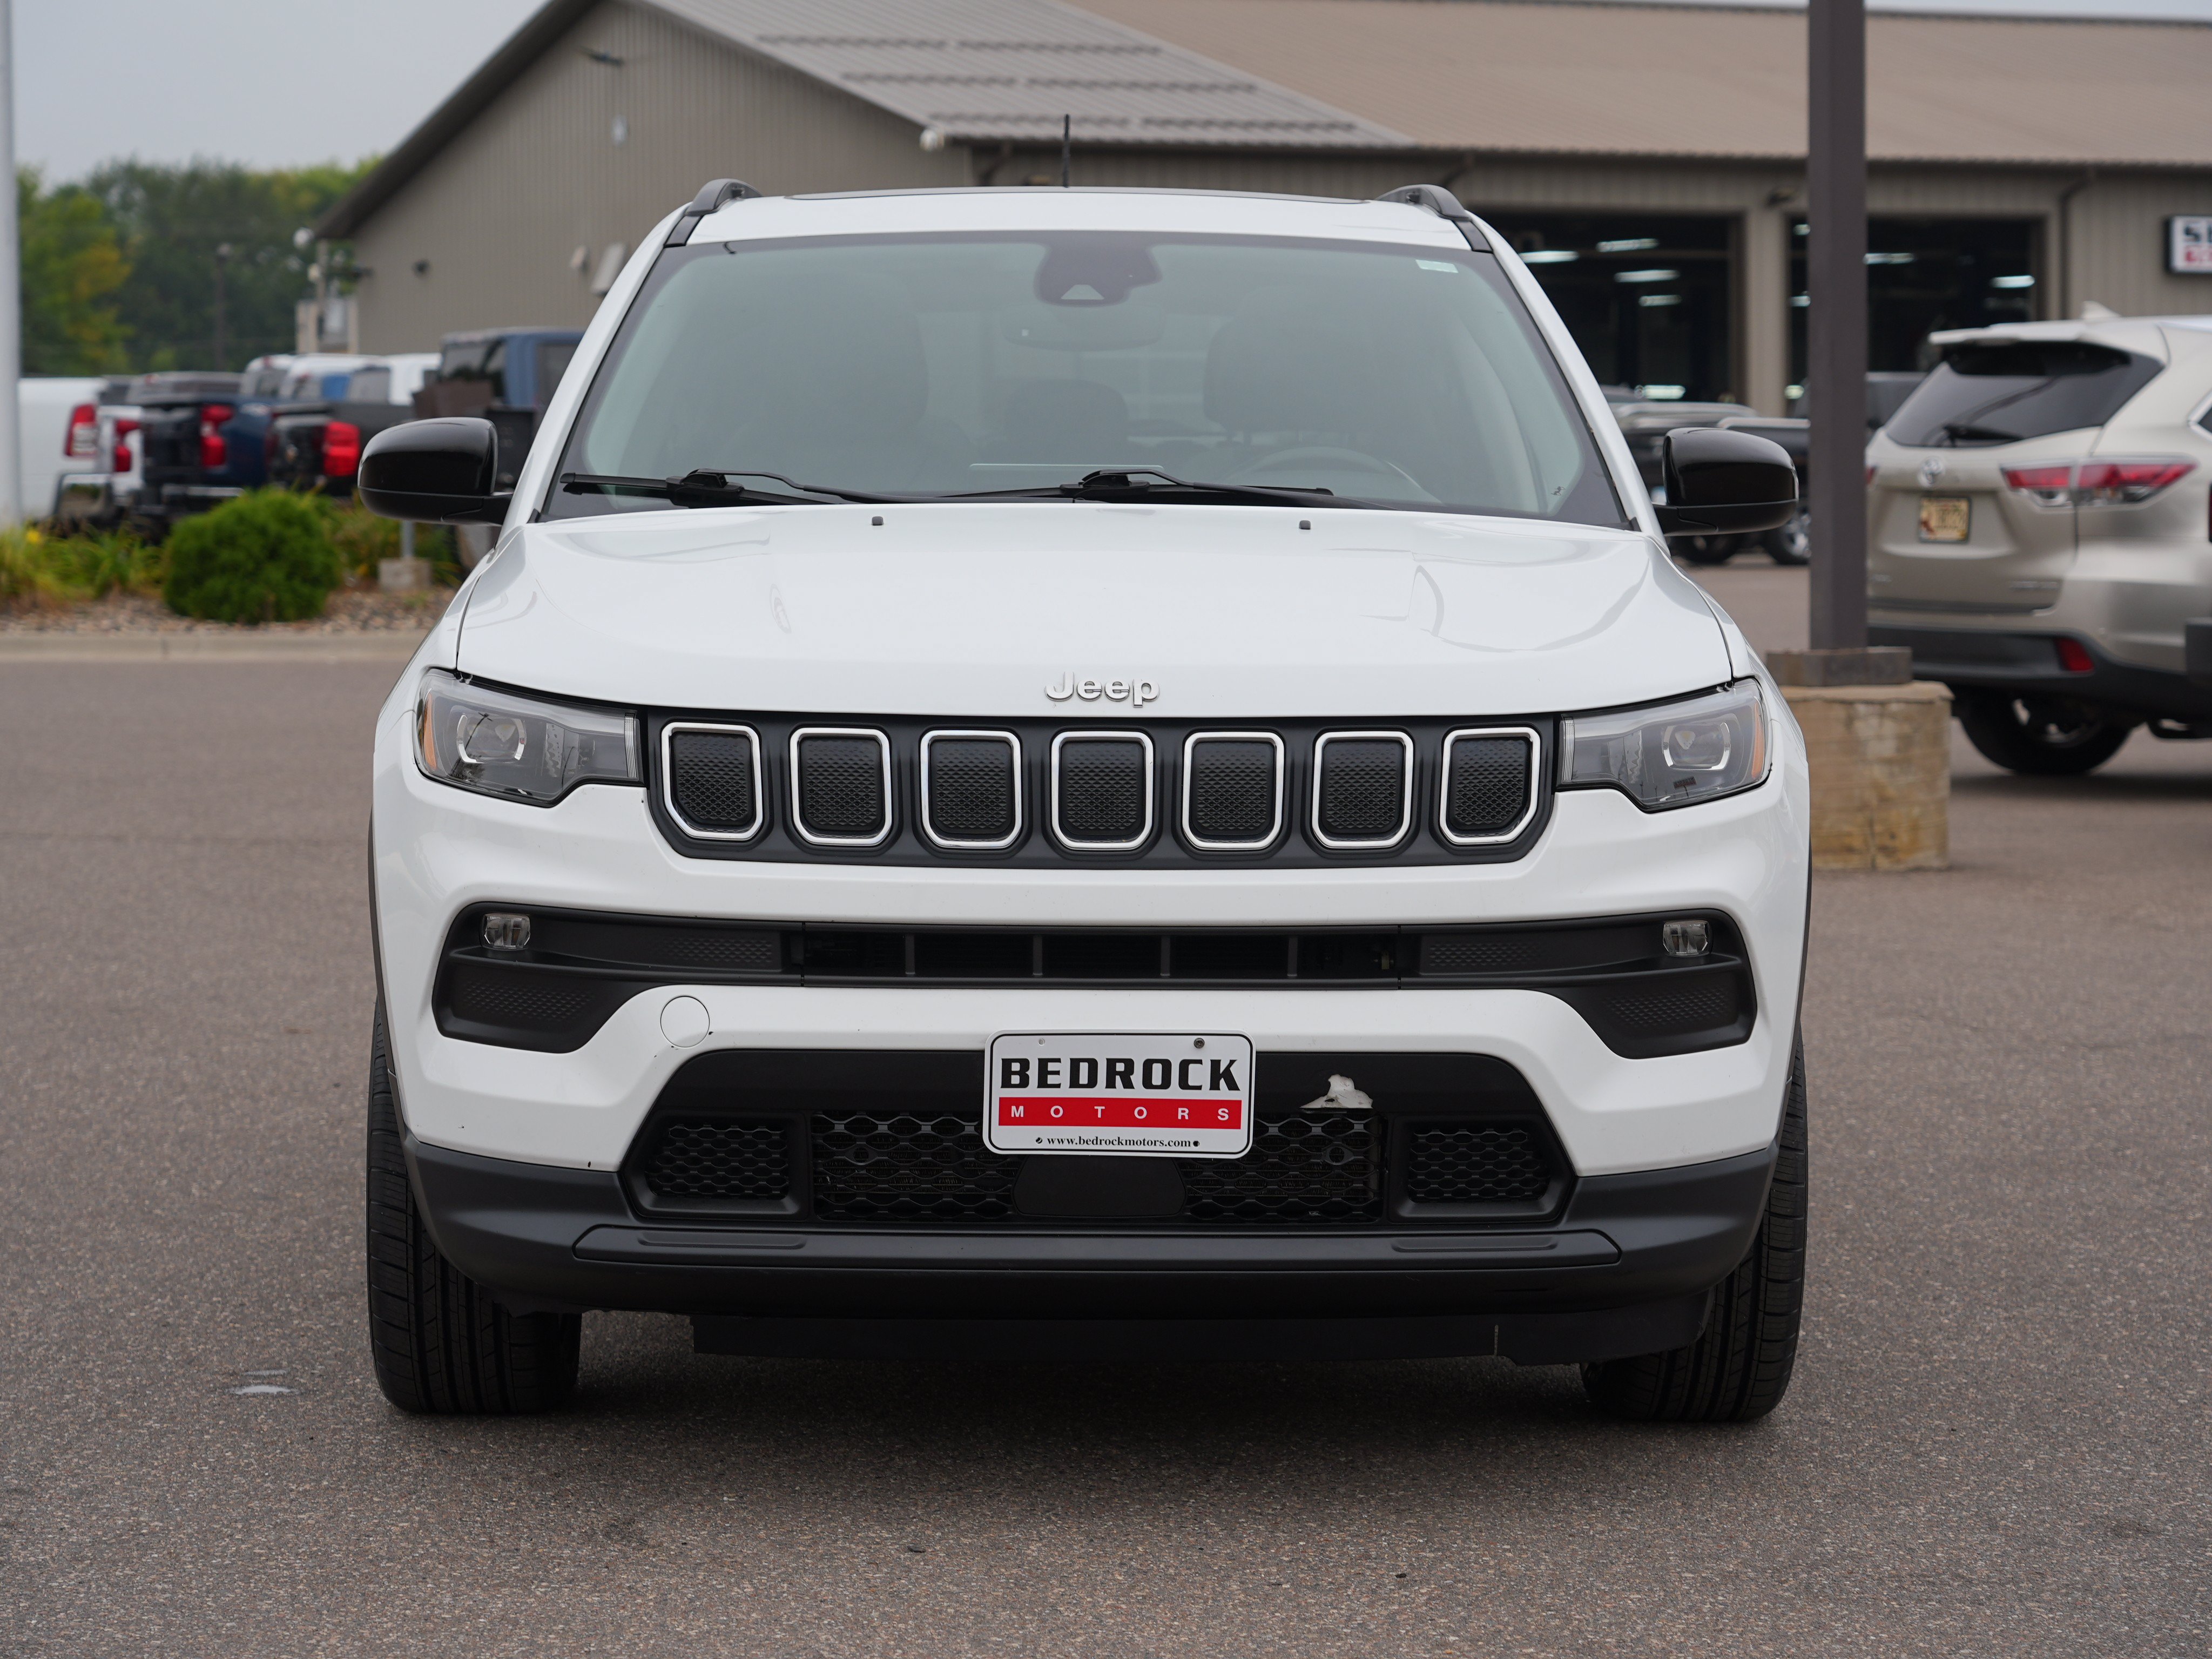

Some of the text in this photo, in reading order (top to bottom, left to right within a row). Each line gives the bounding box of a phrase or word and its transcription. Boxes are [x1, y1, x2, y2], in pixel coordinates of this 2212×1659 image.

[1044, 671, 1160, 708] Jeep
[1000, 1057, 1240, 1091] BEDROCK
[1011, 1105, 1229, 1121] MOTORS
[1047, 1136, 1191, 1148] www.bedrockmotors.com
